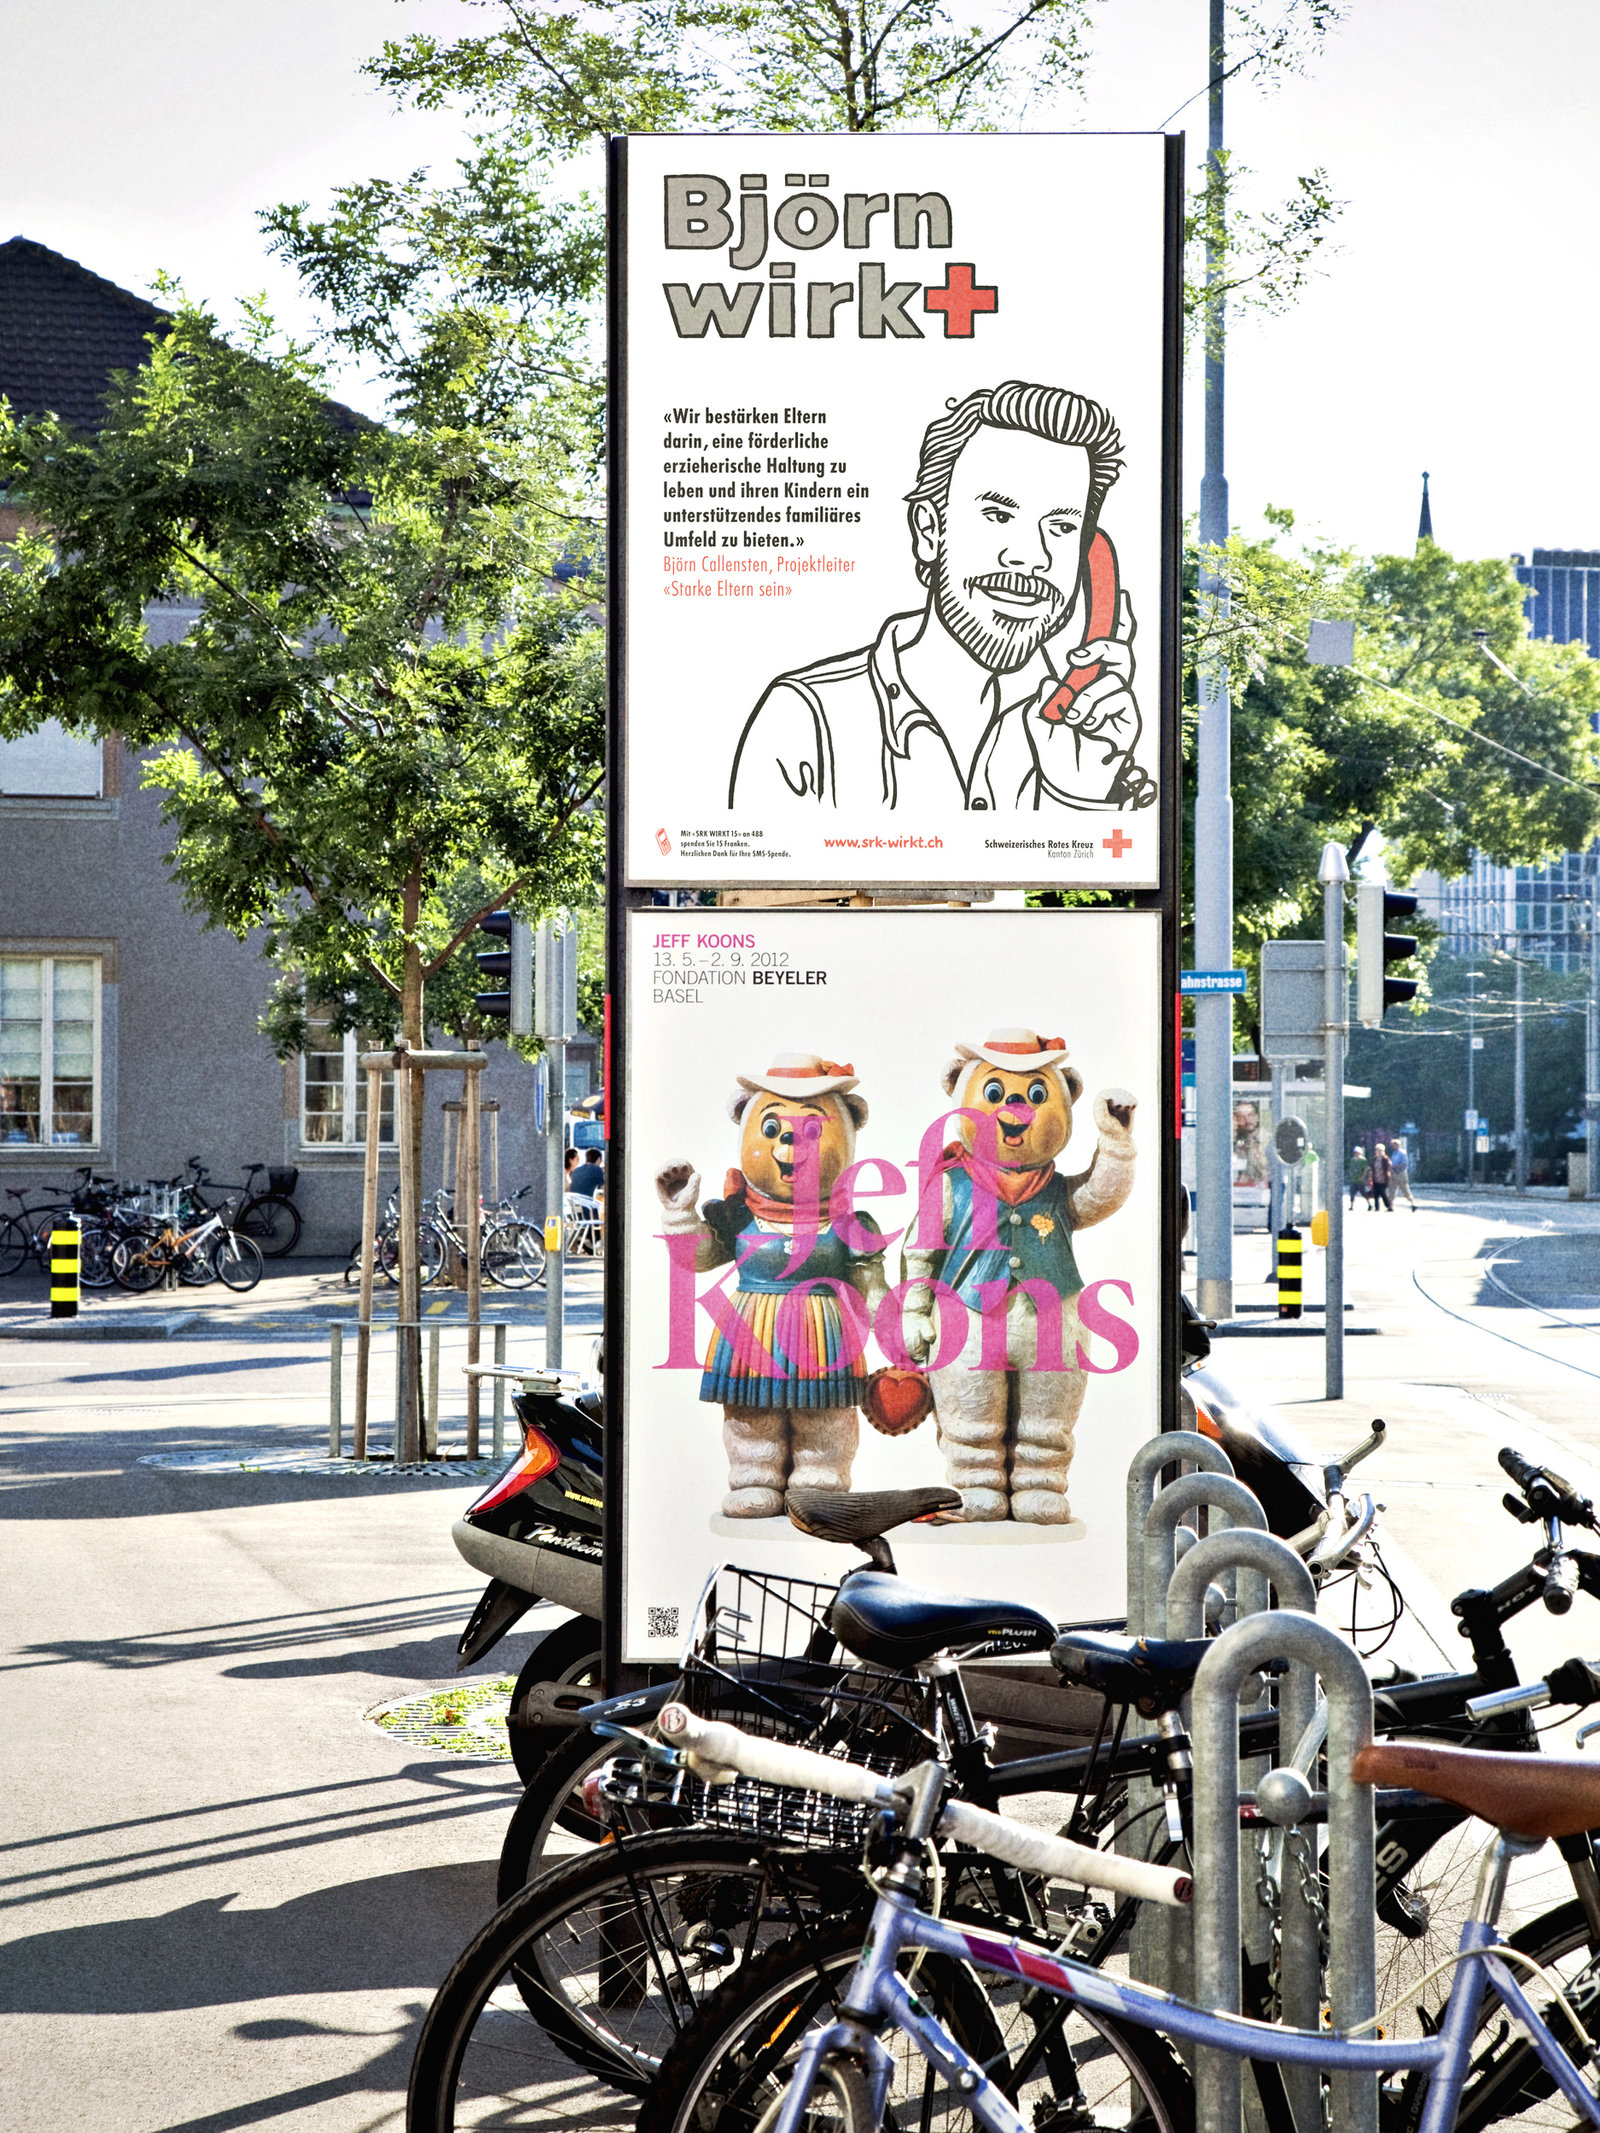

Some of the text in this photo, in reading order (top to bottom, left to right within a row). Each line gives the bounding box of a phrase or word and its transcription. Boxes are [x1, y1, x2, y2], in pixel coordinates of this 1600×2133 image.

[663, 173, 953, 271] Björn
[663, 406, 827, 424] «Wir bestärken Eltern
[663, 431, 829, 452] darin, eine förderliche
[663, 456, 847, 479] erzieherische Haltung zu
[663, 480, 870, 499] leben und ihren Kindern ein
[663, 505, 861, 523] unterstützendes familiäres
[663, 530, 717, 548] Umfeld
[722, 535, 738, 548] zu
[663, 554, 856, 576] Björn Callensten, Projektleiter
[663, 580, 792, 597] «Starke Eltern sein»
[680, 840, 705, 849] spenden
[824, 835, 943, 849] www.srk-wirkt.ch
[984, 839, 1094, 849] Schweizerisches Rotes Kreuz
[680, 849, 712, 857] Herzlichen
[712, 849, 728, 857] Dank
[729, 849, 738, 857] für
[739, 849, 751, 857] Ihre
[1047, 849, 1094, 859] Kanton Zürich
[652, 933, 756, 949] JEFF KOONS
[654, 952, 676, 967] 13.
[730, 952, 745, 967] 9.
[750, 951, 789, 967] 2012
[653, 970, 828, 986] FONDATION BEYELER
[653, 988, 704, 1004] BASEL
[774, 1102, 1036, 1281] Jeff
[652, 1234, 1140, 1380] Koons
[523, 1522, 604, 1557] Pantheon
[1002, 1628, 1037, 1637] PLUSH
